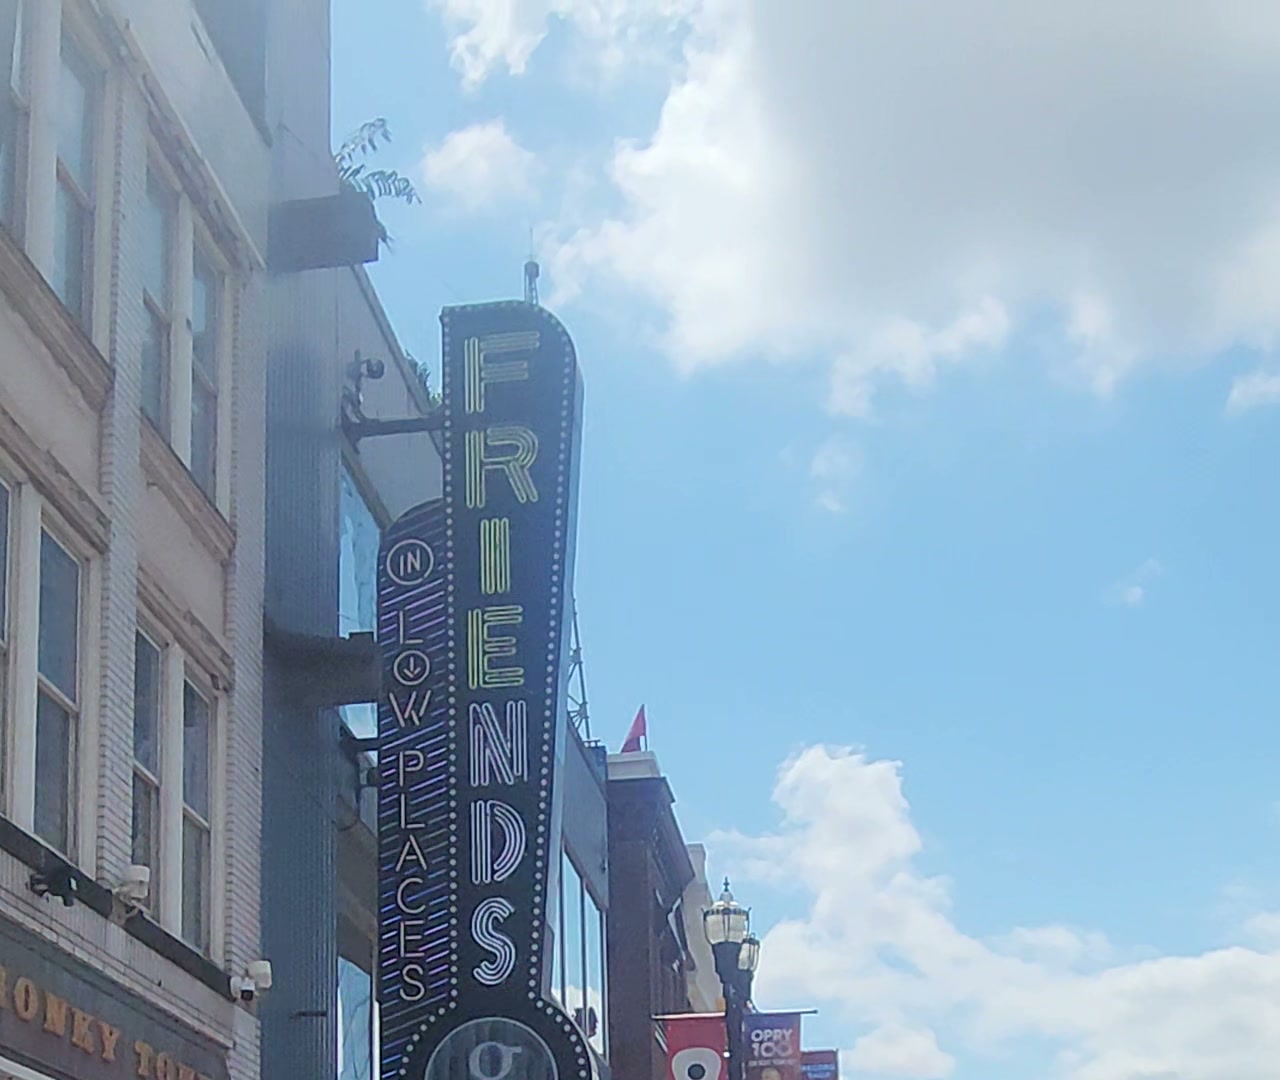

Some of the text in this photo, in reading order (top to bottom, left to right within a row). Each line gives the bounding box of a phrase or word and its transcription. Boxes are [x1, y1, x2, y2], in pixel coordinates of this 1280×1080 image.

[400, 548, 421, 577] IN
[464, 330, 541, 986] FRIENDS
[395, 752, 427, 1001] PLACES
[750, 1028, 793, 1041] OPRY
[751, 1042, 793, 1058] 100
